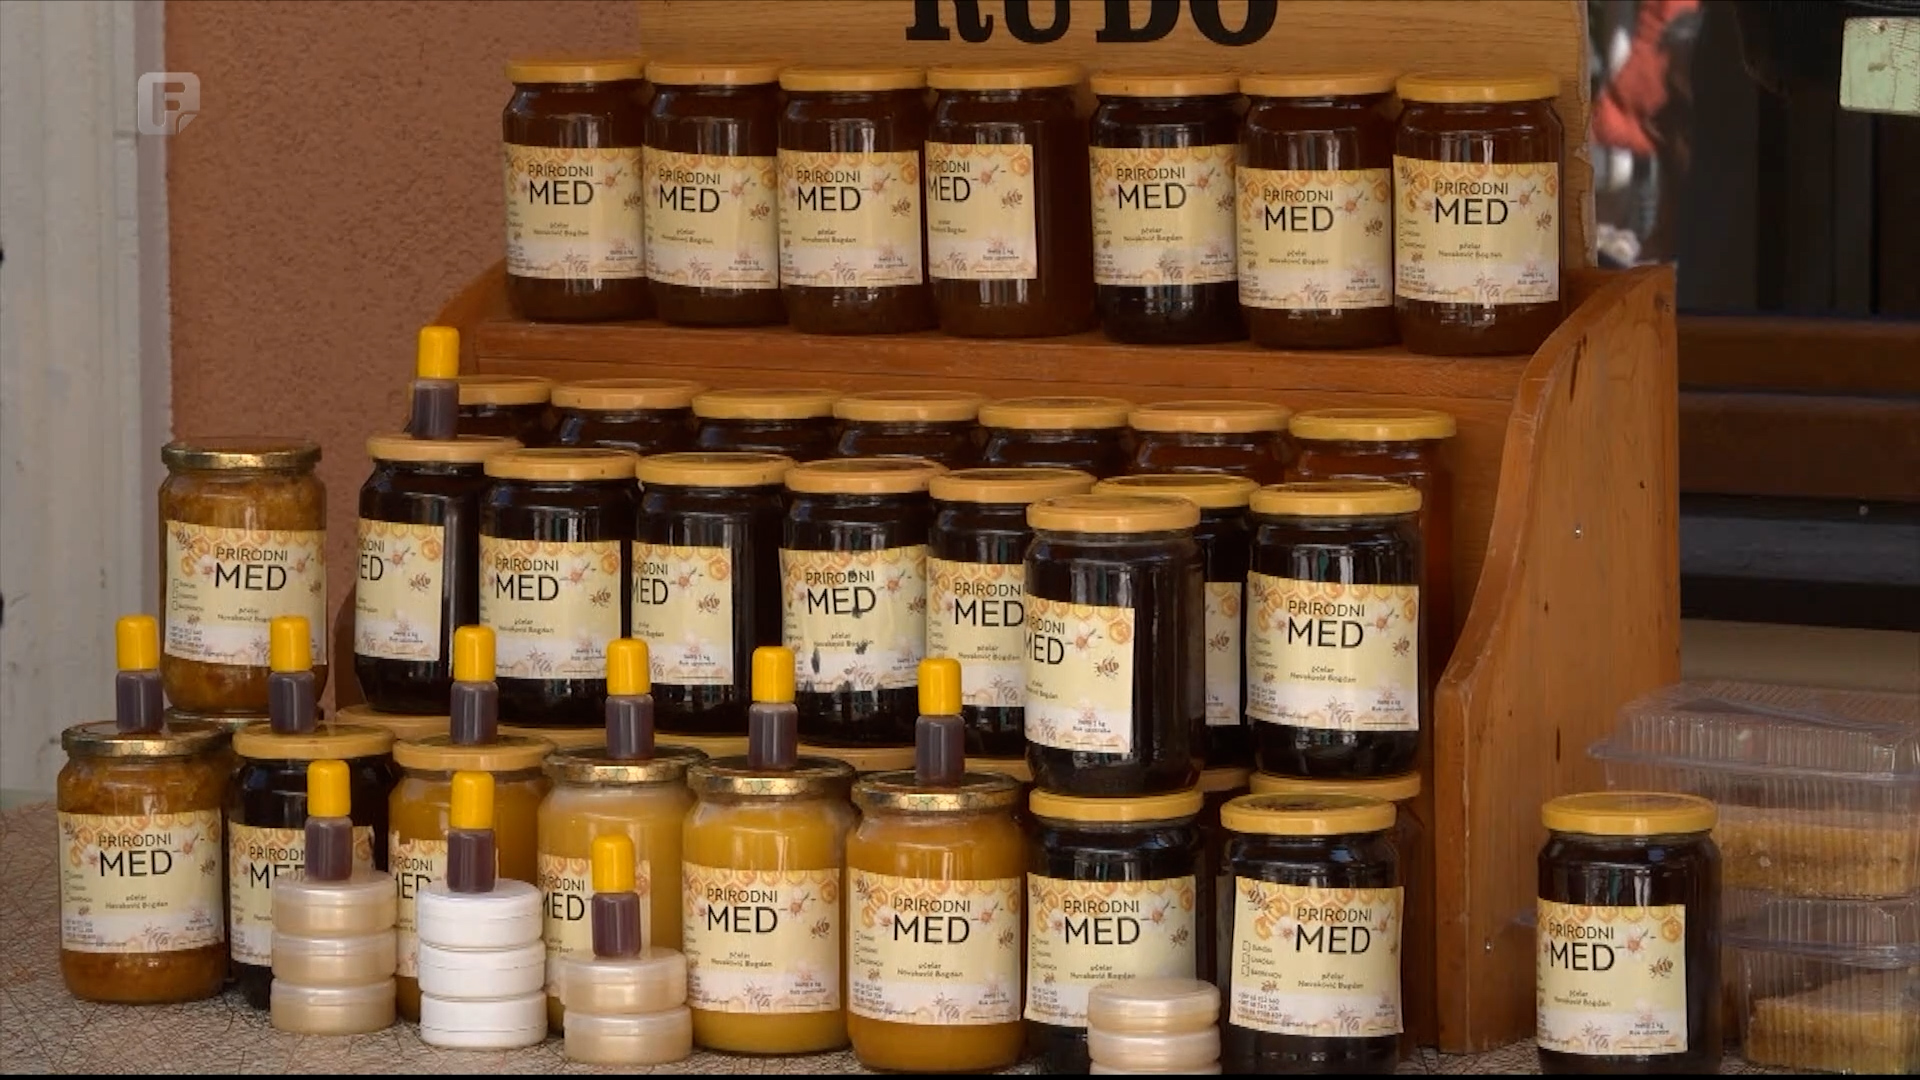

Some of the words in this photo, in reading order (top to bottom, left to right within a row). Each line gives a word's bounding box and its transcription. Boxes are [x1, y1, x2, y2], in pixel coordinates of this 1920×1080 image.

[528, 164, 593, 177] PRIRODNI
[660, 168, 720, 185] PRIRODNI
[797, 170, 860, 183] PRIRODNI
[1117, 166, 1185, 181] PRIRODNI
[529, 180, 594, 205] MED
[660, 184, 720, 213] MED
[798, 186, 861, 211] MED
[1117, 183, 1187, 209] MED
[1264, 188, 1333, 202] PRIRODNI
[1435, 181, 1509, 195] PRIRODNI
[1264, 205, 1334, 232] MED
[1435, 197, 1509, 225] MED
[216, 546, 288, 562] PRIRODNI
[495, 557, 559, 572] PRIRODNI
[215, 562, 287, 591] MED
[360, 553, 384, 581] ED
[806, 569, 874, 584] PRIRODNI
[496, 573, 559, 601] MED
[807, 586, 876, 615] MED
[955, 598, 1024, 627] MED
[1288, 600, 1366, 617] PRIRODNI
[1287, 616, 1364, 650] MED
[99, 832, 172, 847] PRIRODNI
[100, 849, 172, 877] MED
[707, 888, 778, 903] PRIRODNI
[894, 897, 971, 913] PRIRODNI
[1063, 900, 1140, 914] PRIRODNI
[707, 904, 778, 933] MED
[1297, 907, 1372, 923] PRIRODNI
[893, 914, 970, 944] MED
[1064, 916, 1140, 945] MED
[1296, 924, 1371, 954] MED
[1549, 922, 1614, 940] PRIRODNI
[1550, 940, 1615, 971] MED
